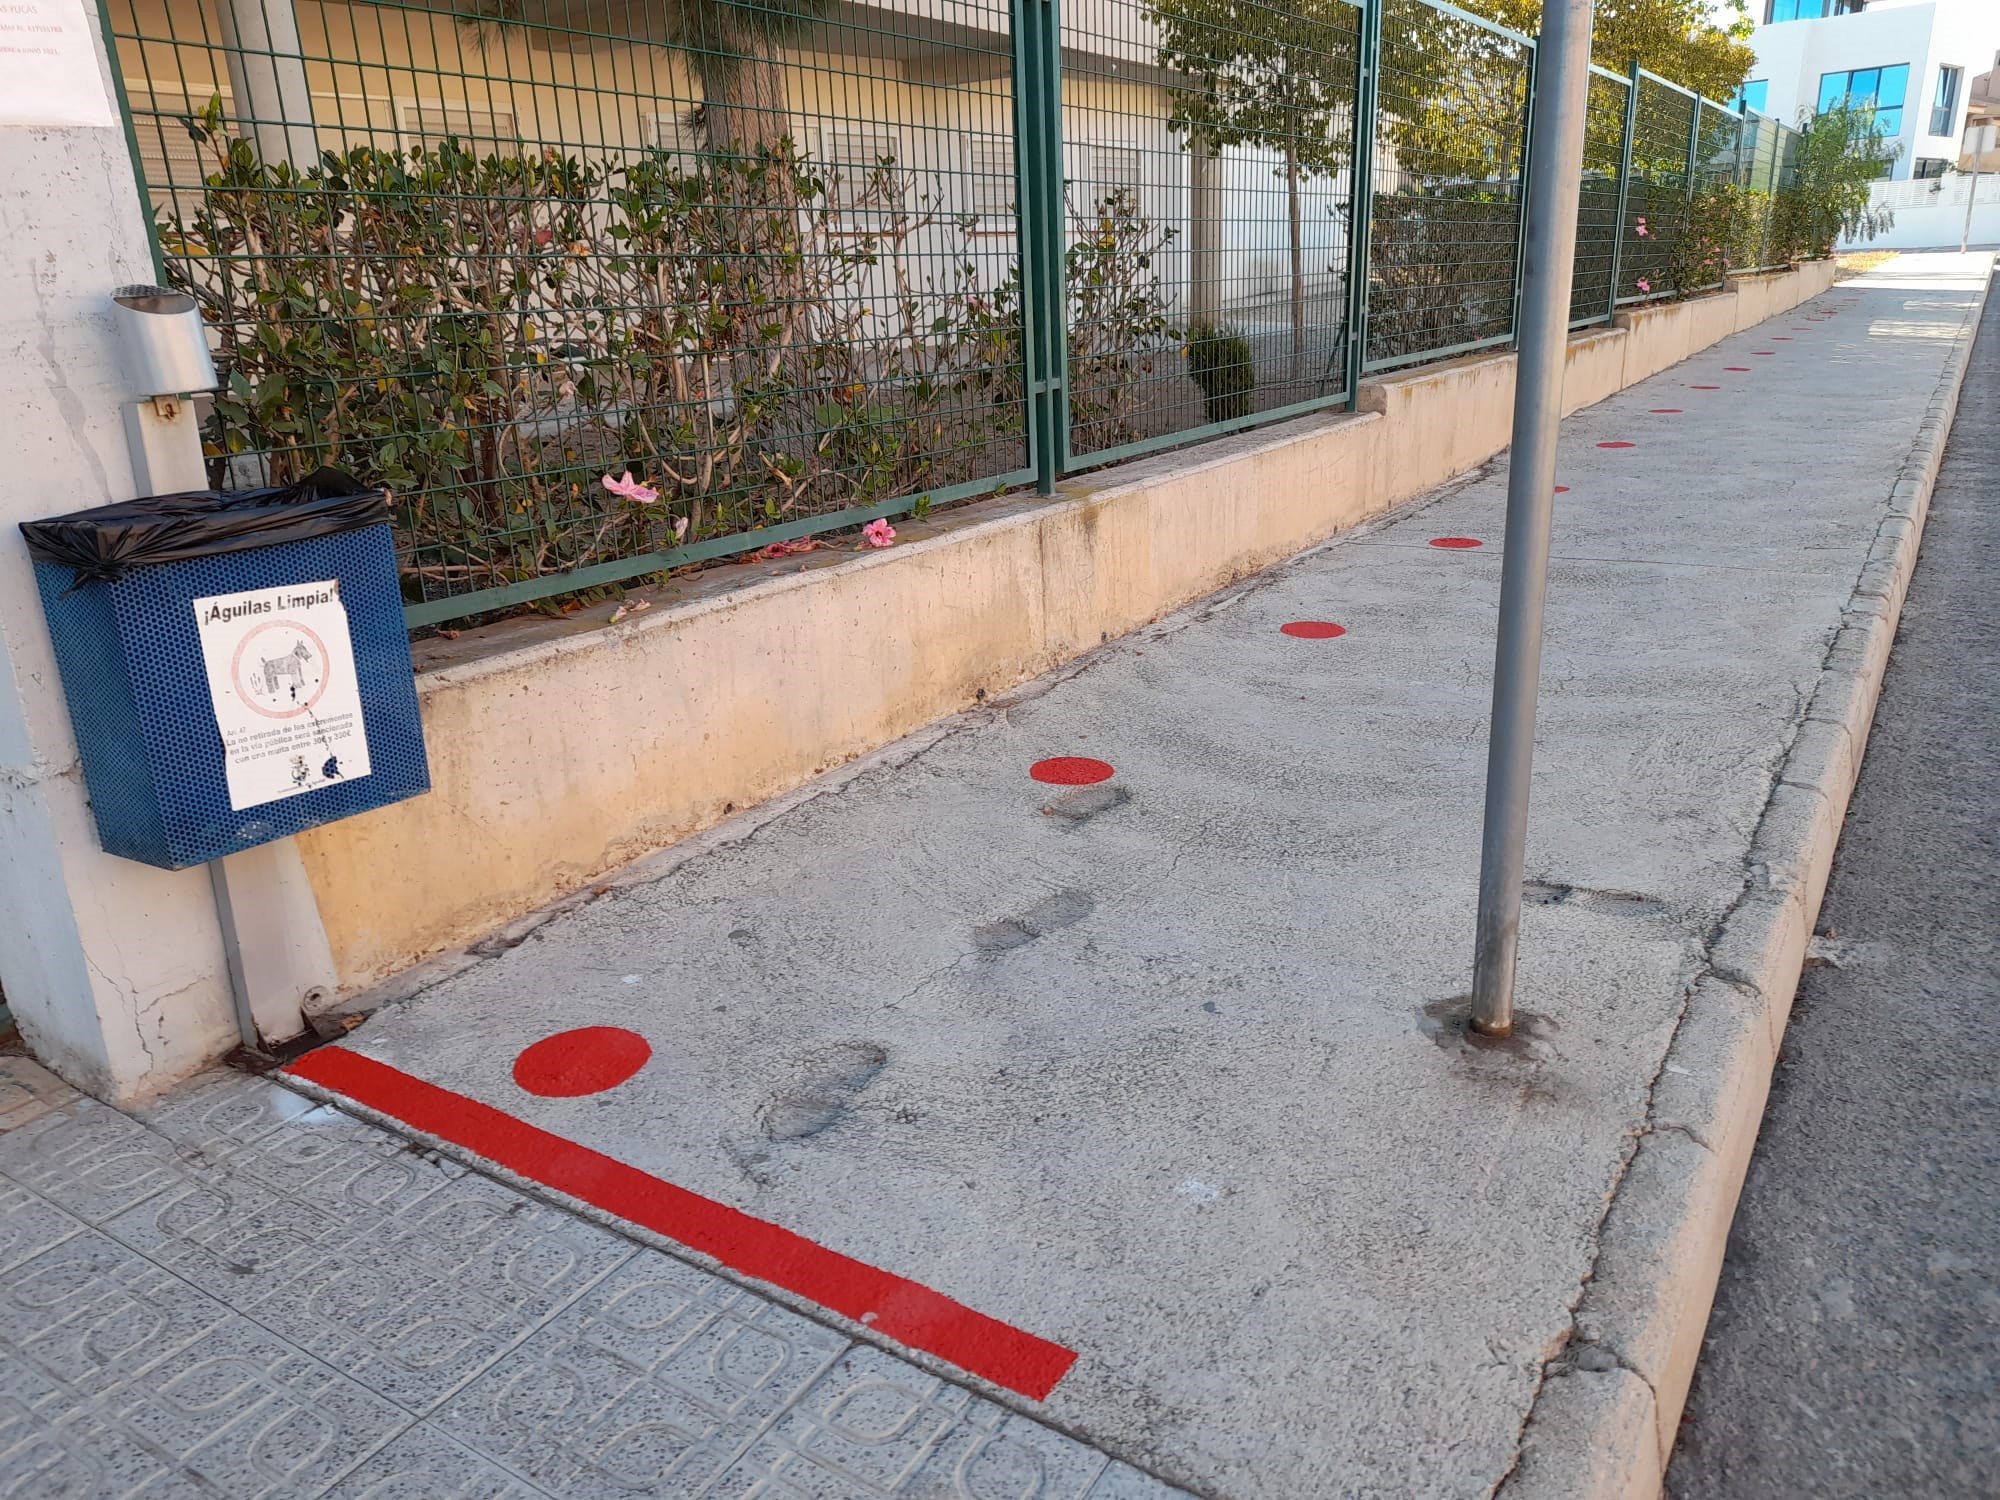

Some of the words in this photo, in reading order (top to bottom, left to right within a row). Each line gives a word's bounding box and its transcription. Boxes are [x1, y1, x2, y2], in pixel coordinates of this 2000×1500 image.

[204, 600, 272, 626] ¡Águilas
[277, 588, 333, 610] Limpia!
[226, 739, 236, 747] La
[238, 736, 248, 744] no
[250, 729, 281, 741] retirada
[293, 723, 305, 731] los
[312, 721, 353, 736] sancionada
[291, 740, 311, 751] entre
